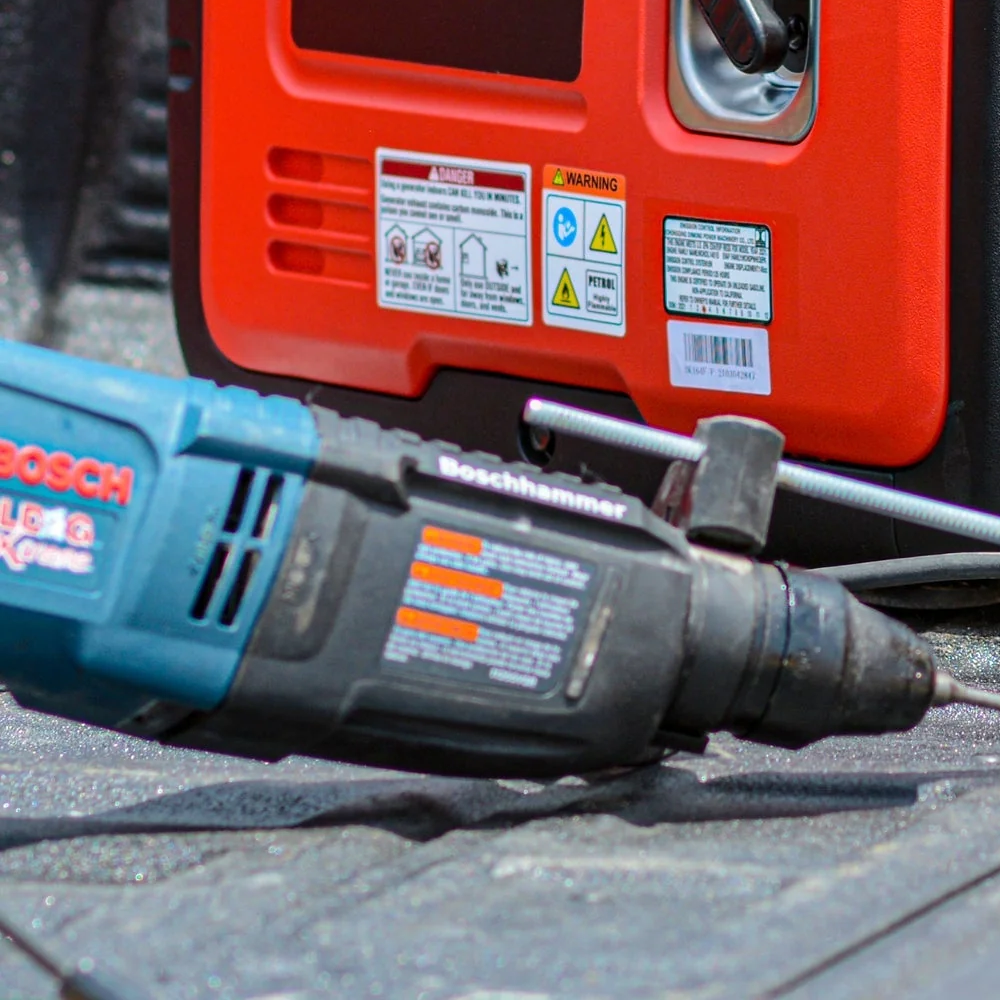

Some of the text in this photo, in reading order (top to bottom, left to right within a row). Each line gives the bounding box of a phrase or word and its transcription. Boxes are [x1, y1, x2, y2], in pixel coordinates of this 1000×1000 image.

[439, 167, 475, 185] DANGER
[566, 171, 618, 192] WARNING
[588, 275, 616, 291] PETROL
[438, 455, 628, 520] Boschhammer
